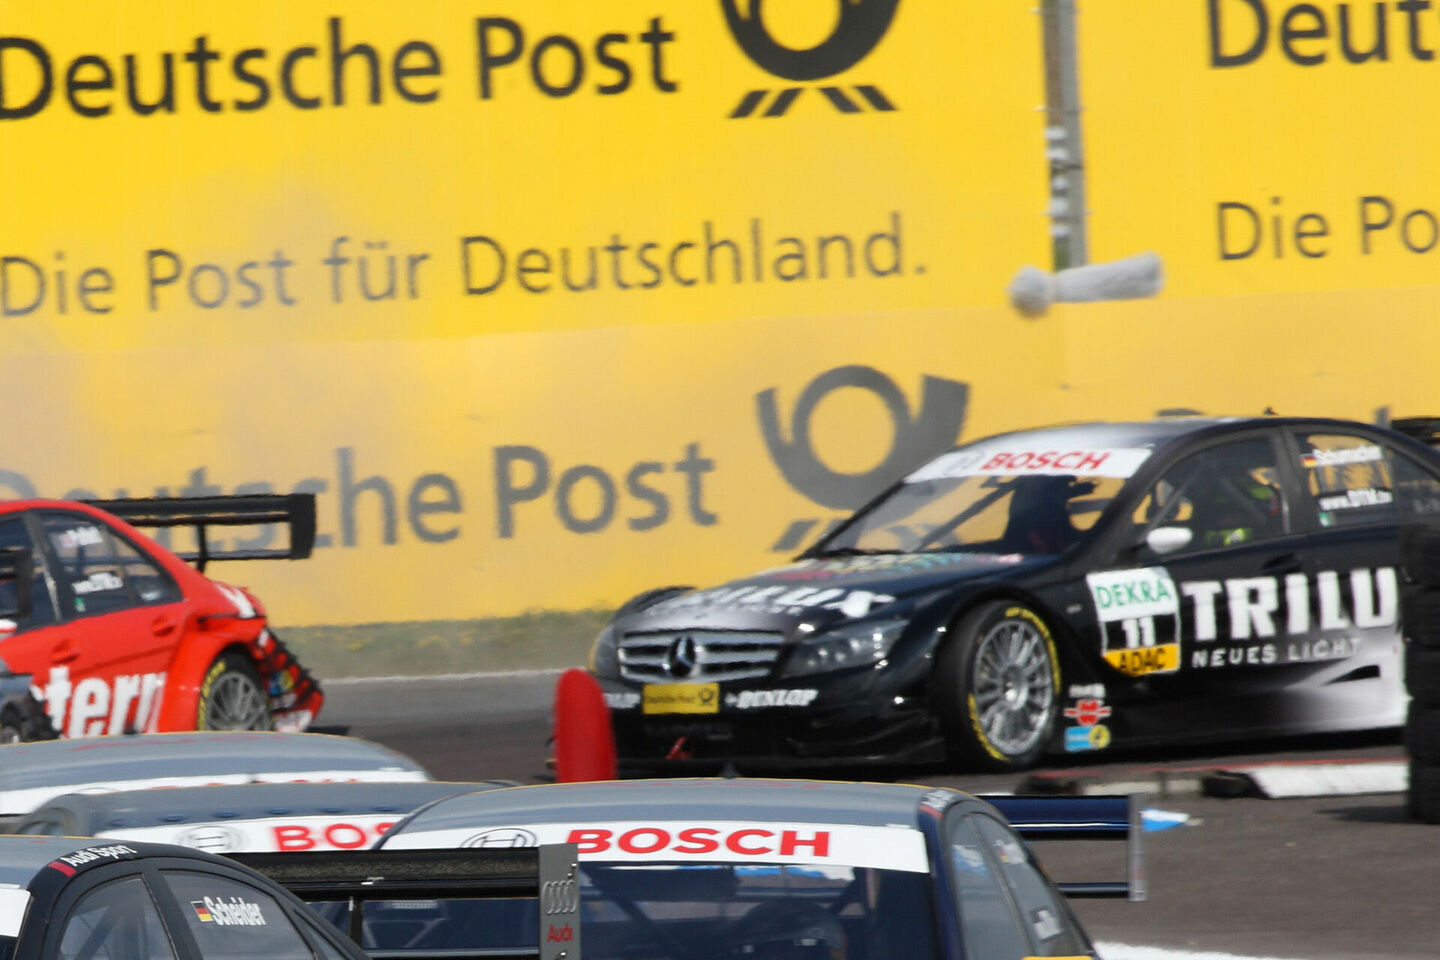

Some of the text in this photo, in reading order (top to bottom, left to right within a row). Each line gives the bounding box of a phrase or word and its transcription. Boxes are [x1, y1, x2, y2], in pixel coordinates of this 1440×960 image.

[1205, 0, 1440, 68] Deut
[476, 15, 680, 99] Post
[1216, 196, 1330, 262] Die
[144, 248, 297, 312] Post
[322, 235, 432, 304] für
[459, 212, 927, 297] Deutschland.
[980, 450, 1111, 472] BOSCH
[492, 442, 719, 538] Post
[1095, 579, 1172, 610] DEKRA
[1121, 616, 1157, 649] 11
[1118, 648, 1167, 673] ADAC
[1191, 637, 1363, 668] NEUES LICHT
[29, 666, 167, 738] tern
[564, 827, 831, 858] BOSCH
[203, 896, 267, 927] Scheider
[547, 923, 573, 943] Audi
